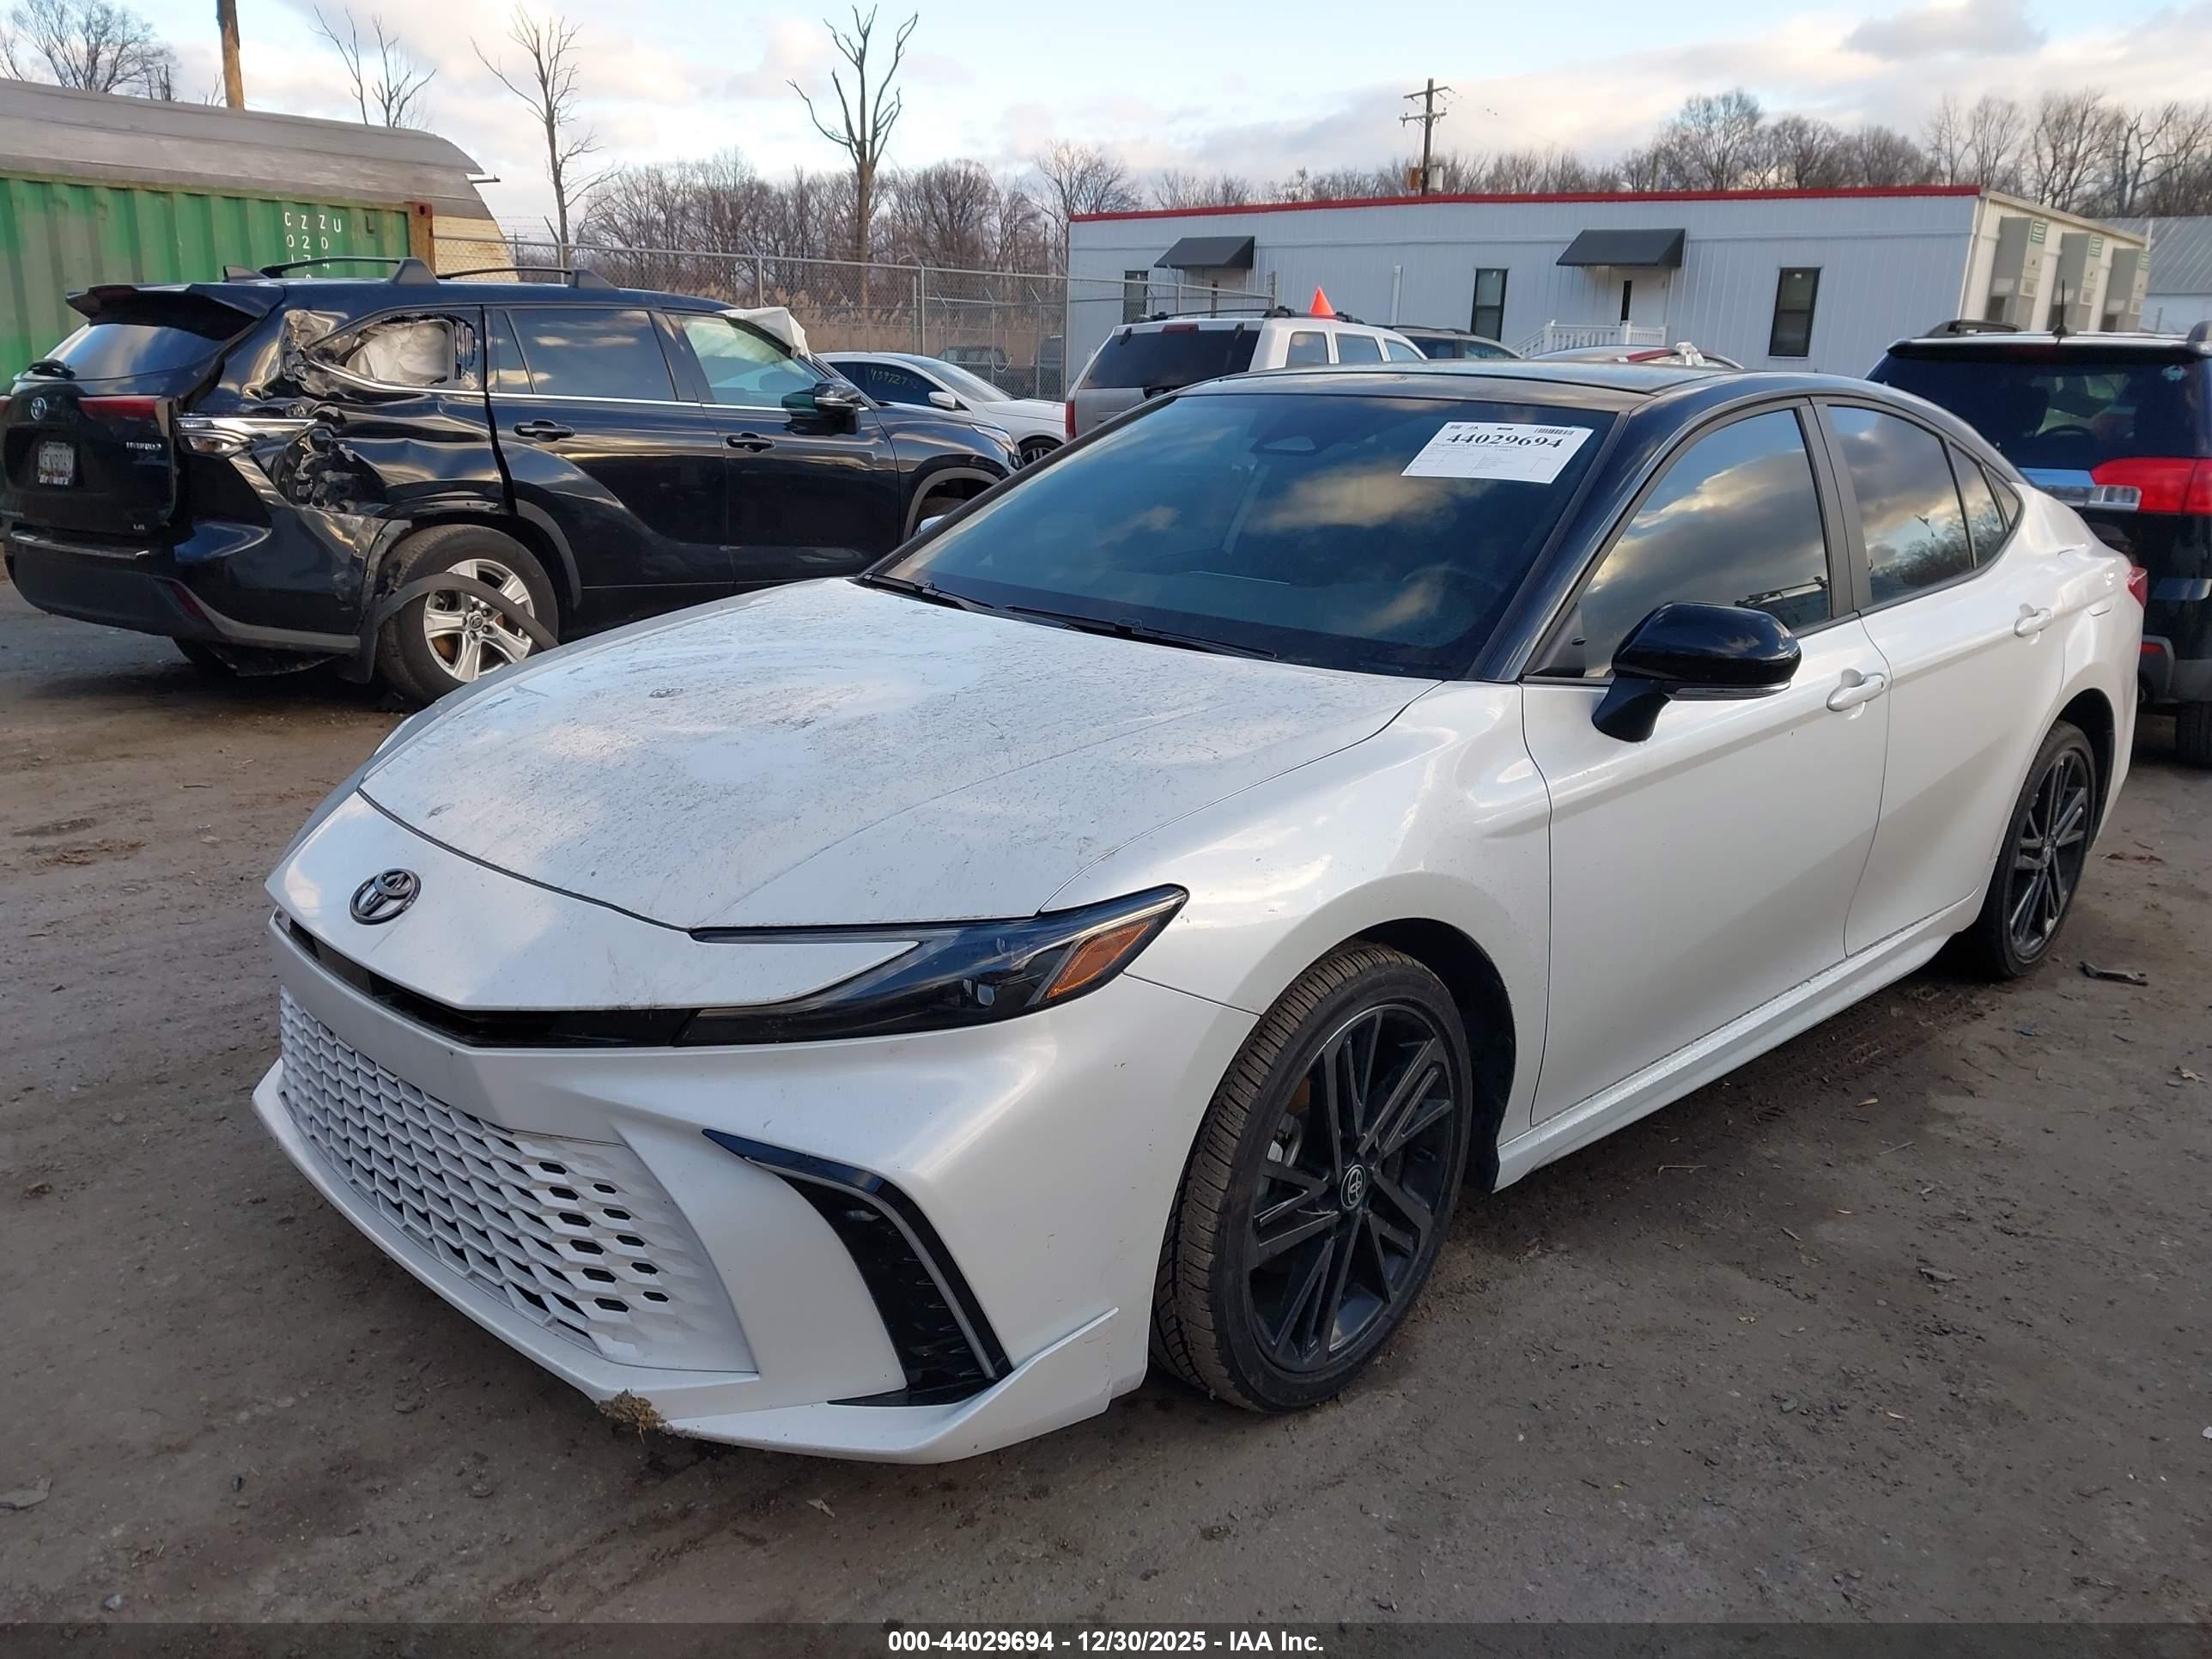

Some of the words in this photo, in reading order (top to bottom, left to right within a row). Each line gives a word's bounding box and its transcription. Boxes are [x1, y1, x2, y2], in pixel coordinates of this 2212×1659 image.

[284, 211, 342, 233] CZZU
[287, 234, 328, 249] 020
[1446, 434, 1564, 448] 44029694
